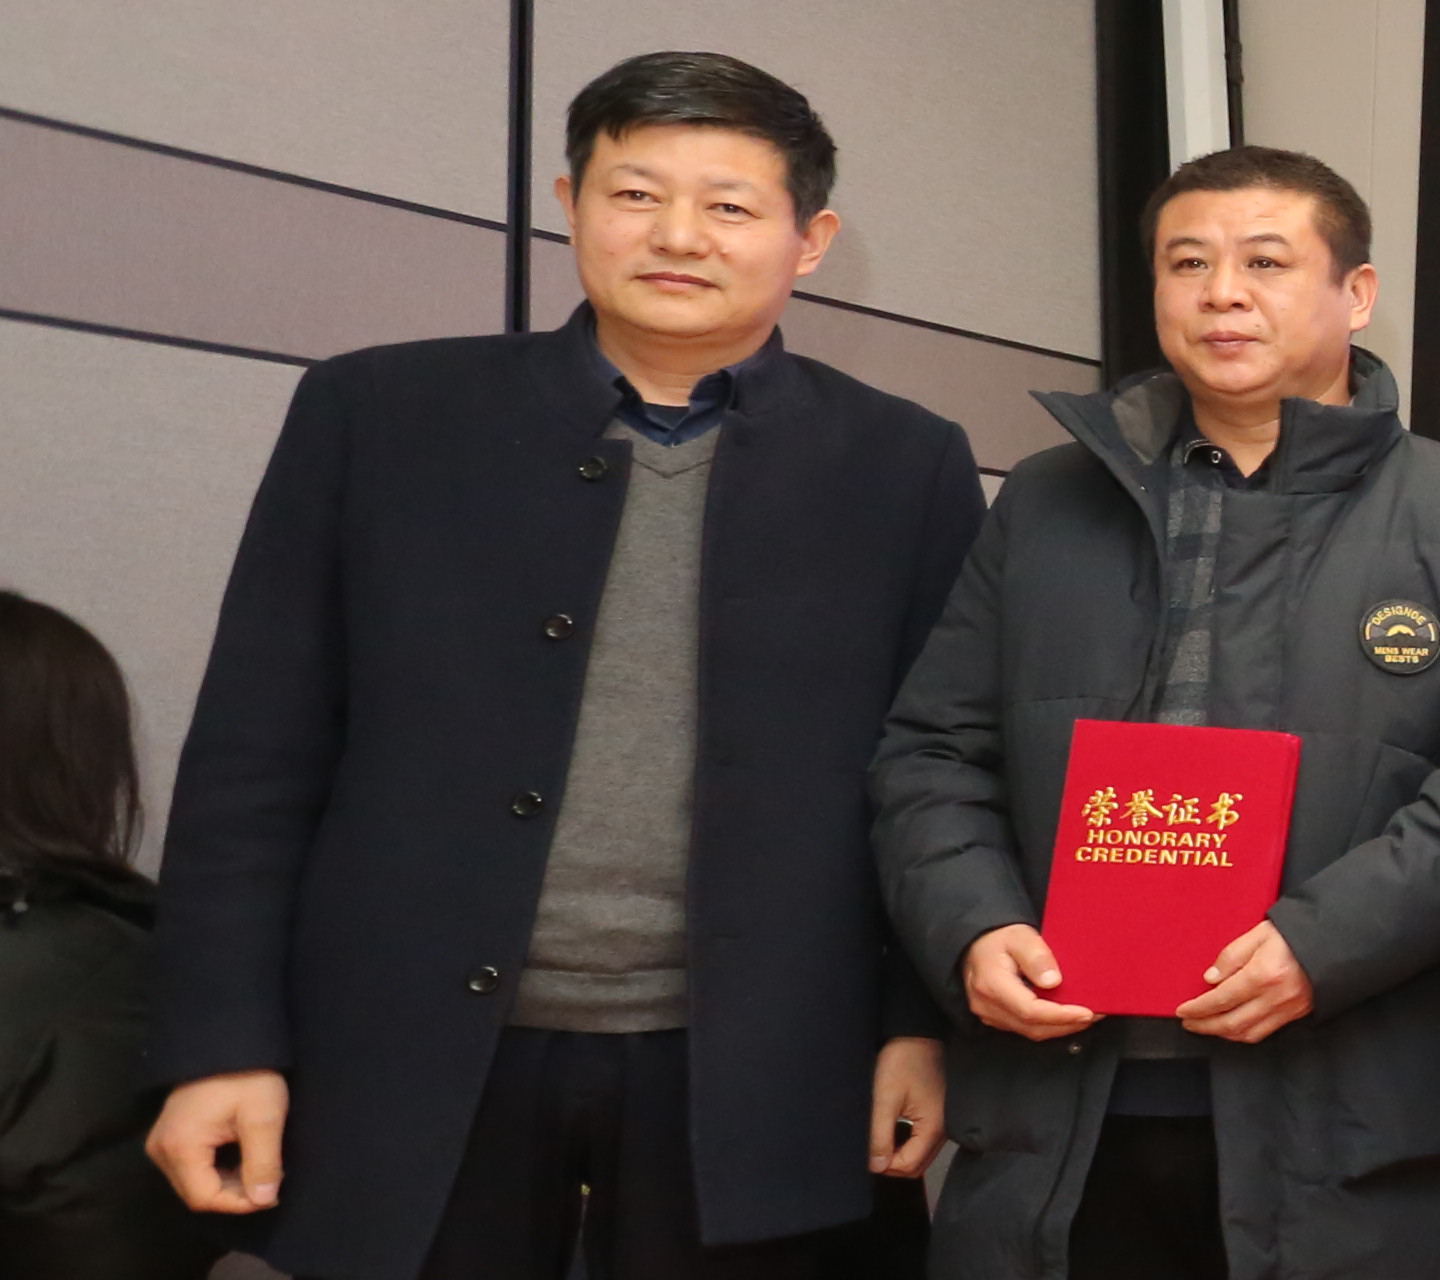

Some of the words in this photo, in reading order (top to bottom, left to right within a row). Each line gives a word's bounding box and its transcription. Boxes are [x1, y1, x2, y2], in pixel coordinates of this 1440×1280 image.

[1081, 786, 1244, 831] 荣誉证书
[1086, 829, 1228, 849] HONORARY
[1075, 846, 1234, 868] CREDENTIAL
